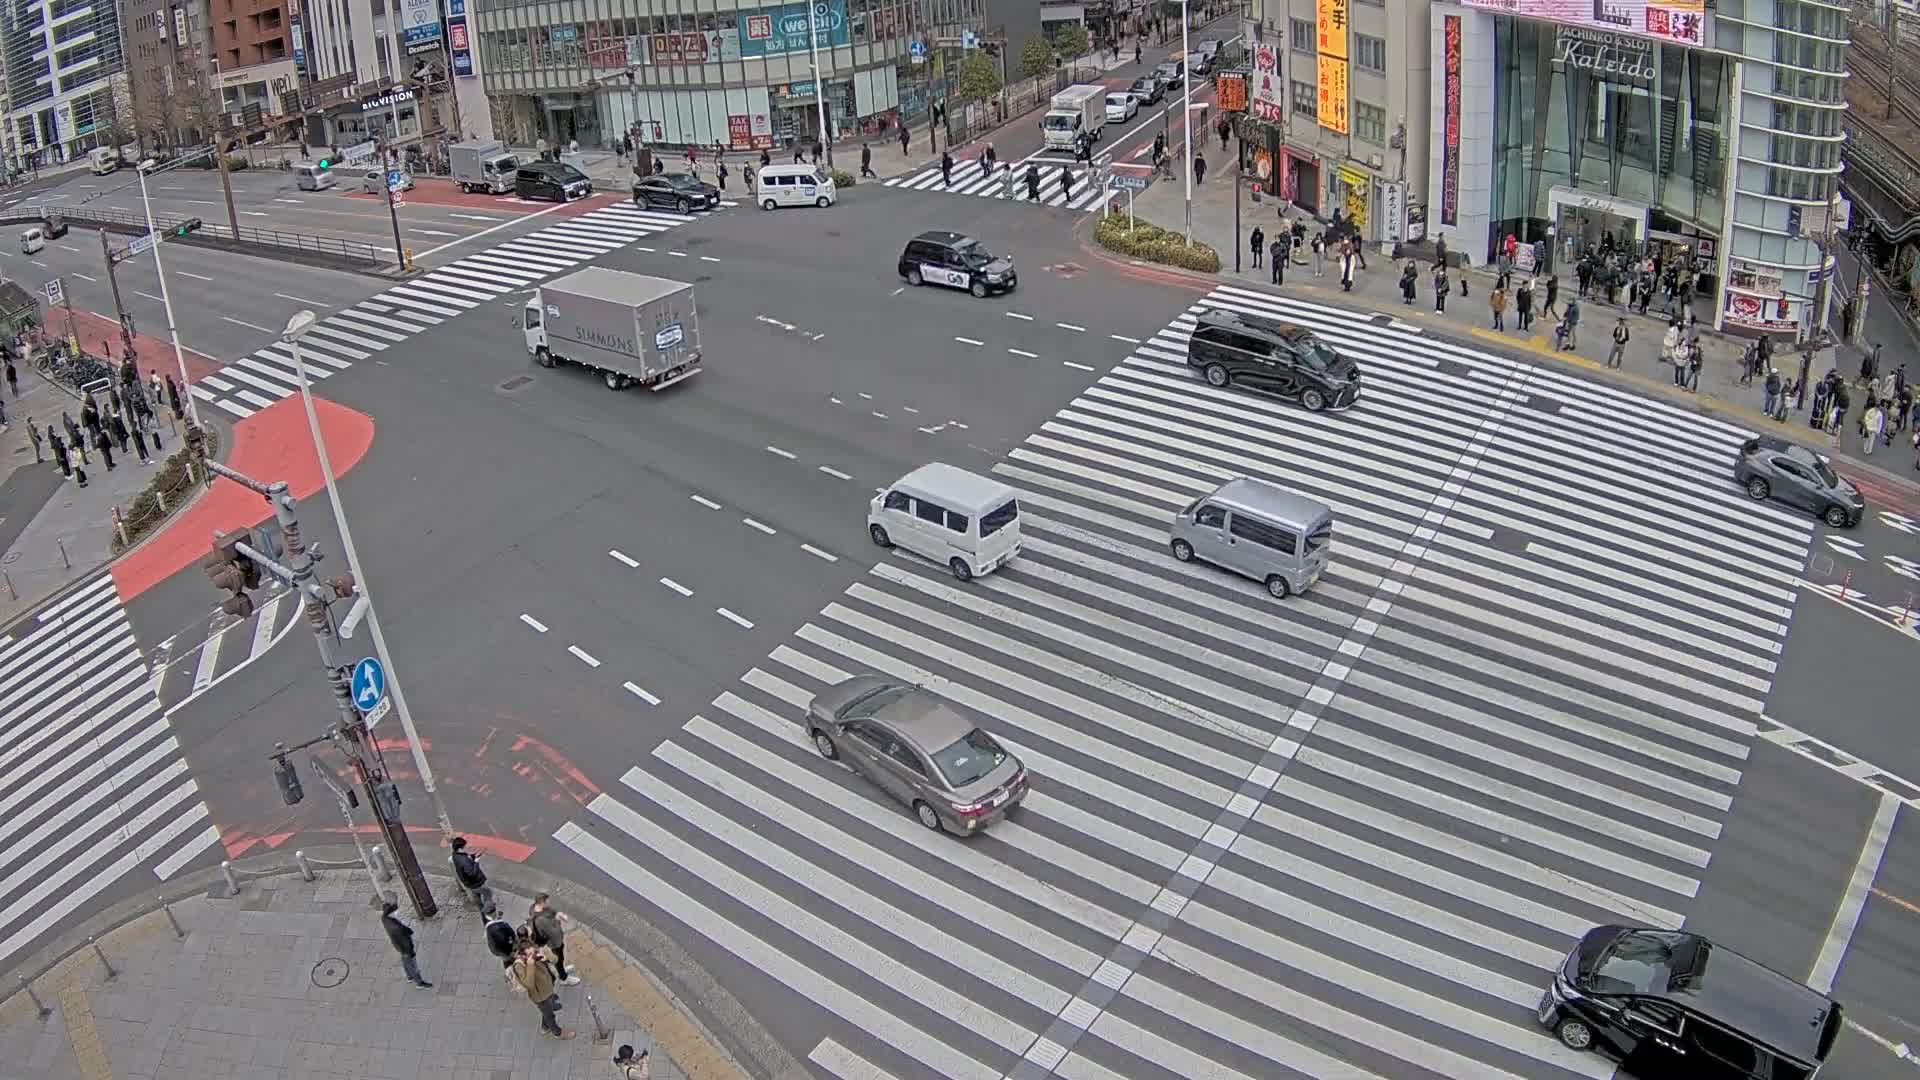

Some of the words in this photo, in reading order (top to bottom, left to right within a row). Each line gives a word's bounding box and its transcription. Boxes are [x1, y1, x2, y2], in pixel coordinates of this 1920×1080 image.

[765, 33, 828, 50] 処方せん付
[1556, 25, 1613, 44] PACHINKO
[1624, 37, 1652, 52] SLOT
[1552, 38, 1657, 80] Kaleido
[576, 326, 634, 353] SIMMONS
